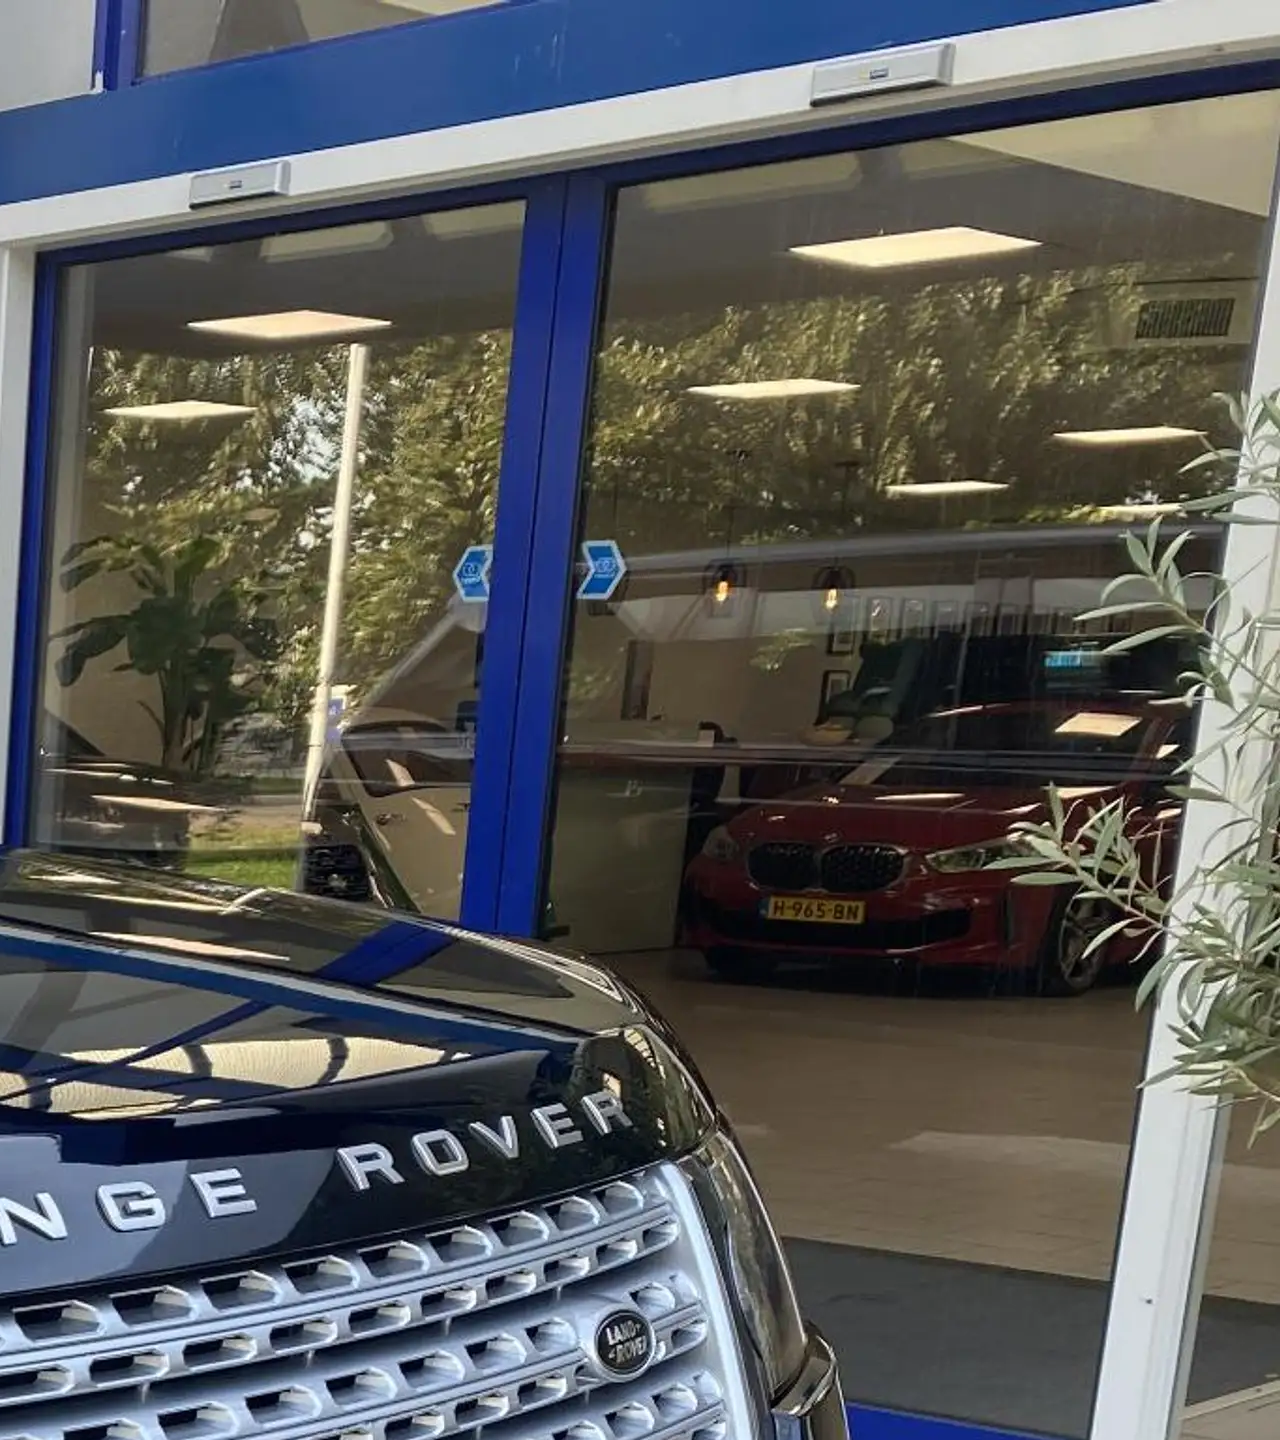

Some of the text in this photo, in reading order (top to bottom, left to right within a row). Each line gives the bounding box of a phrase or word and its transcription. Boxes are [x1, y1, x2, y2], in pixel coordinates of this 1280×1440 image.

[773, 900, 860, 920] H-965-BN
[338, 1089, 635, 1192] ROVER
[606, 1320, 636, 1346] LAND
